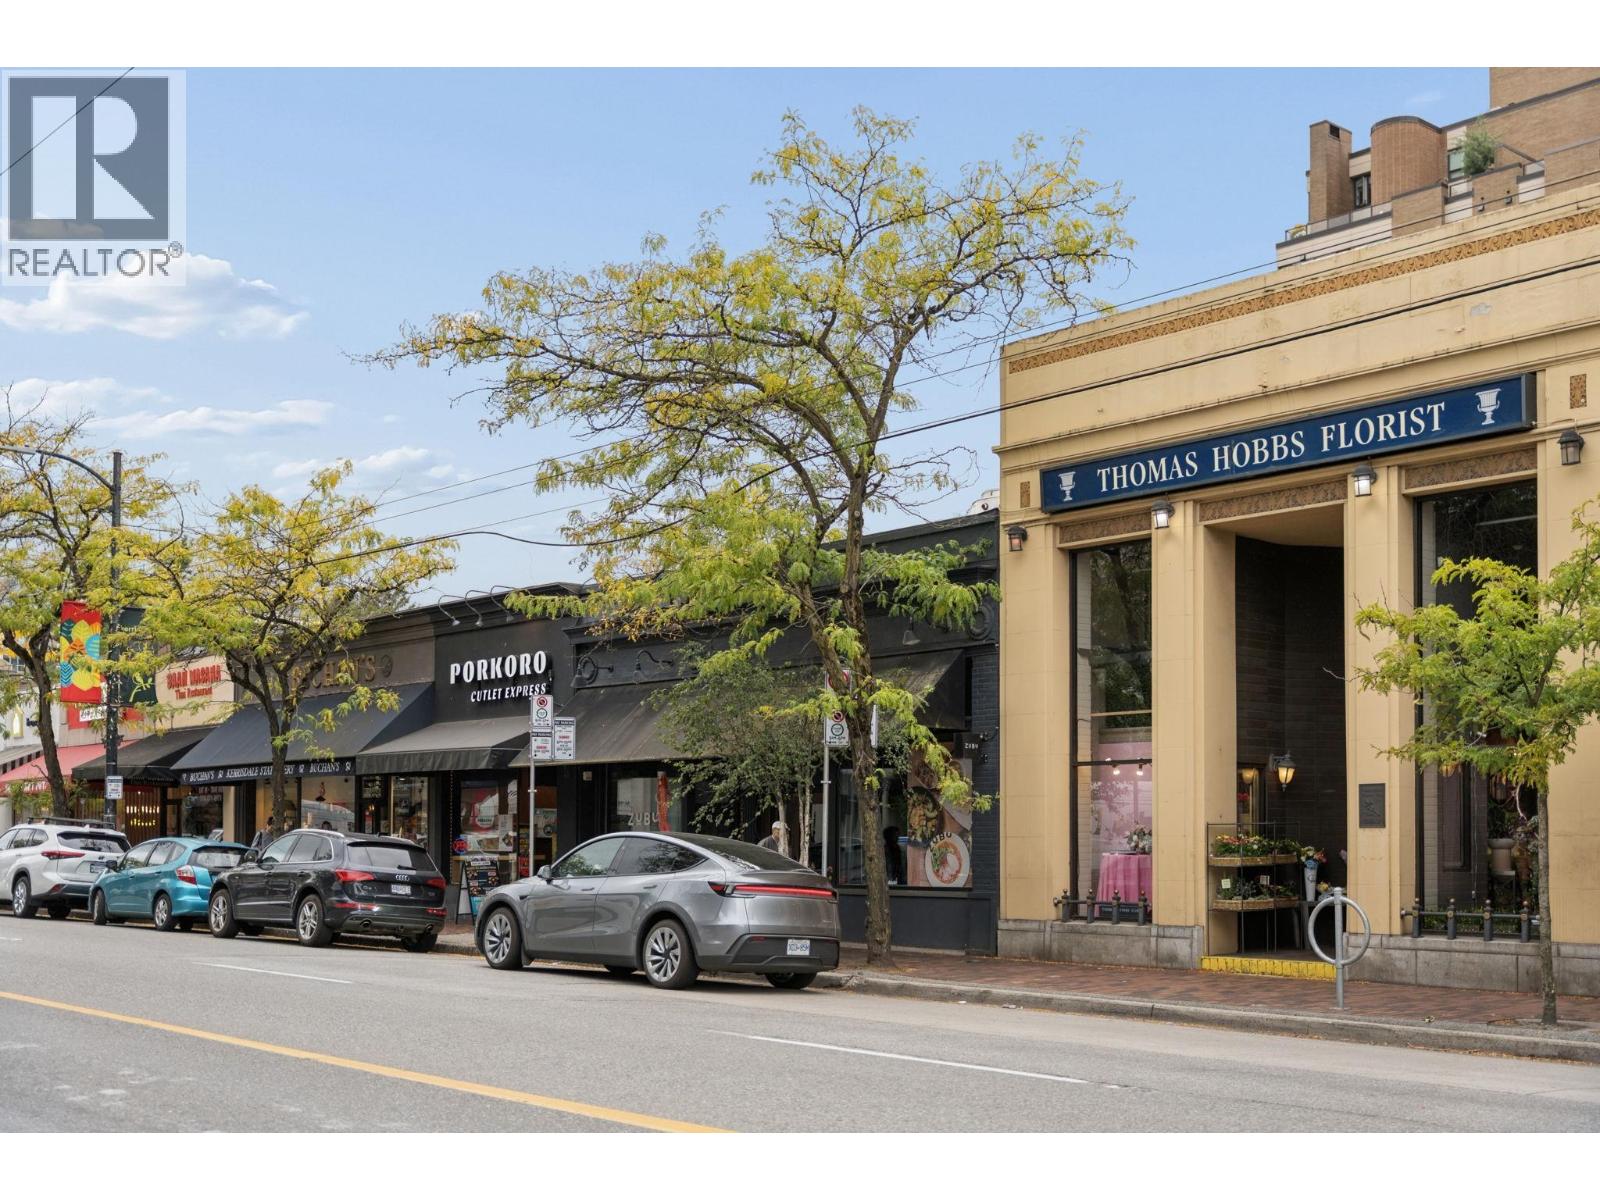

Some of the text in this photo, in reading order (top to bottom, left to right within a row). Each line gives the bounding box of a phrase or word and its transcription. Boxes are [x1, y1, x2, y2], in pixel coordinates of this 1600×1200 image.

[1097, 401, 1446, 492] THOMAS HOBBS FLORIST
[449, 650, 547, 685] PORKORO
[470, 682, 547, 703] CUTLET EXPRESS
[225, 766, 259, 778] KERRISDALE
[309, 762, 341, 773] BUCHAN'S
